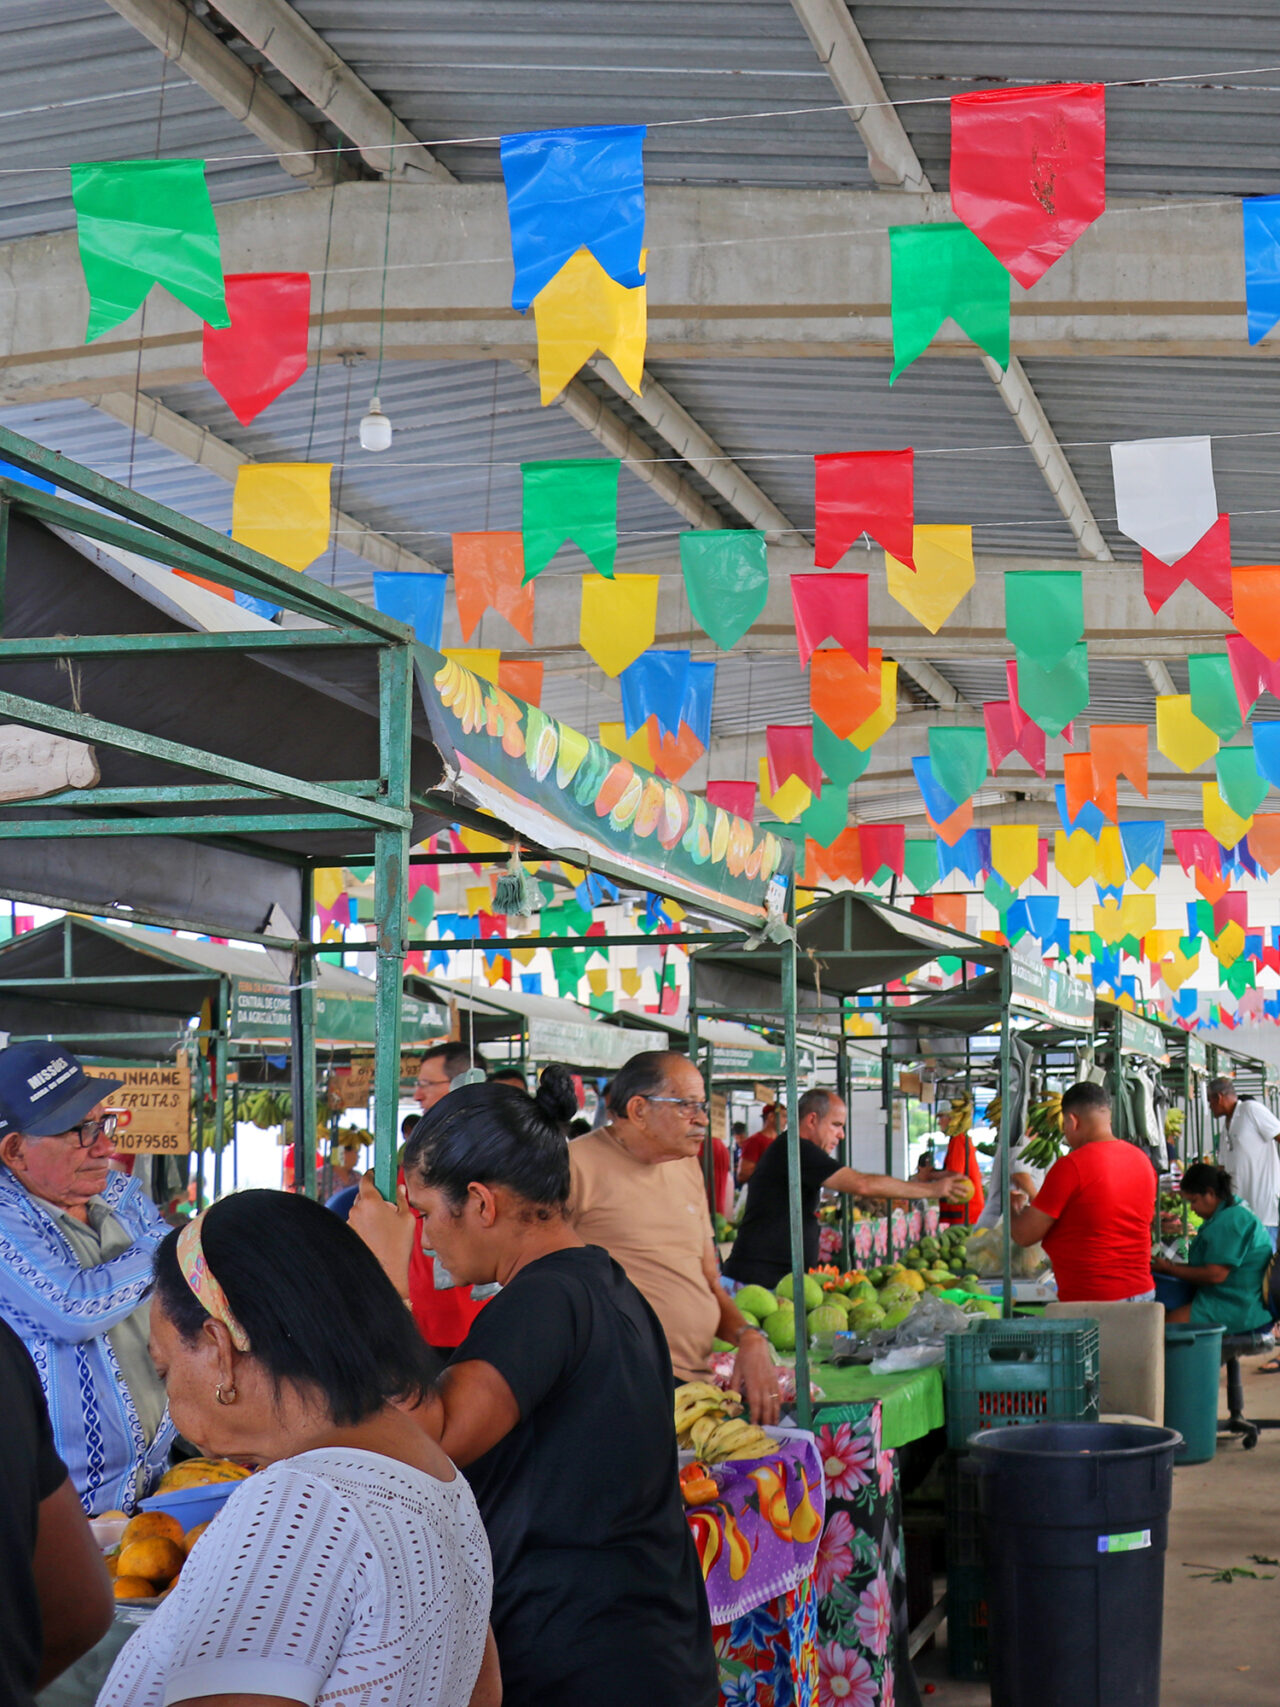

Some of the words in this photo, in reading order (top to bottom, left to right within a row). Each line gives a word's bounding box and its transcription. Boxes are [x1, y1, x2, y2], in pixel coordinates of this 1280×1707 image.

[27, 1057, 68, 1090] MISSÕES
[123, 1072, 181, 1086] INHAME
[120, 1093, 180, 1107] FRUTAS
